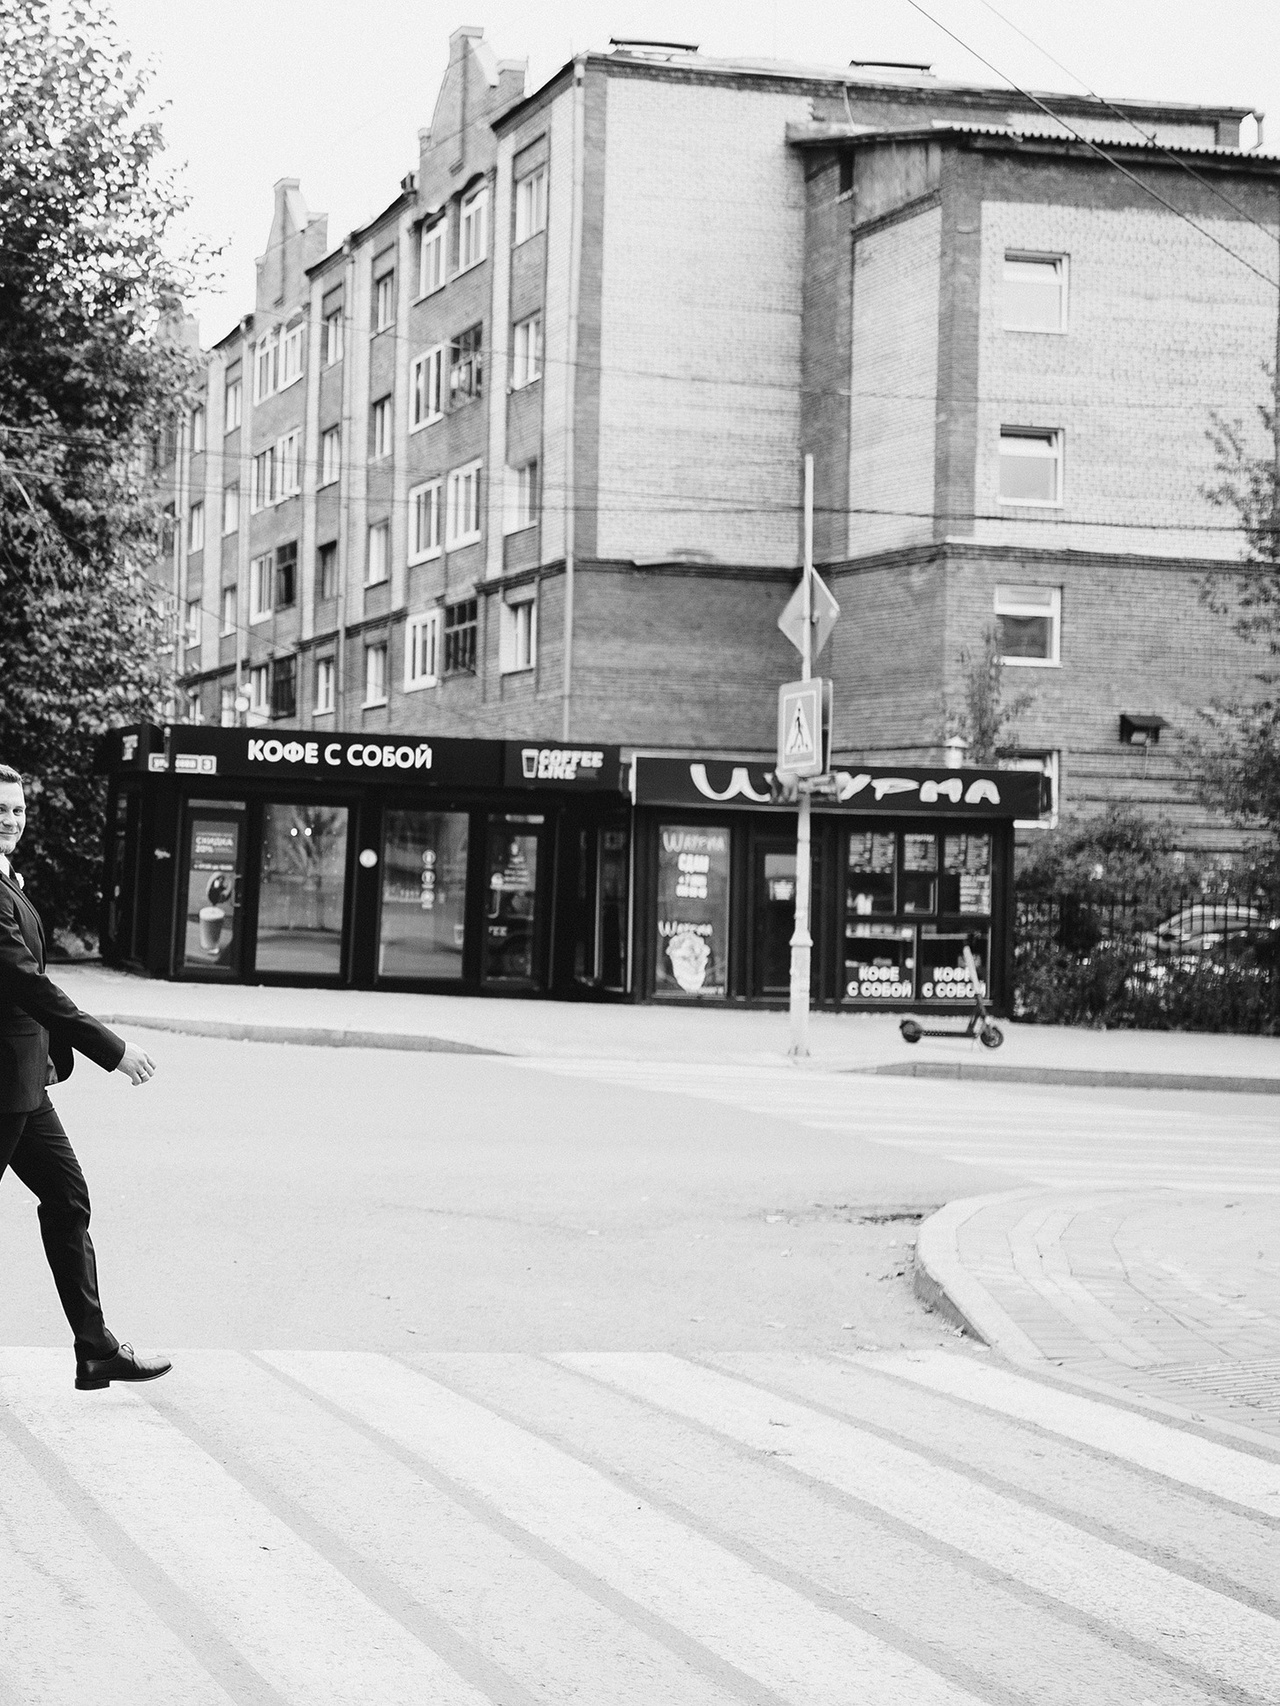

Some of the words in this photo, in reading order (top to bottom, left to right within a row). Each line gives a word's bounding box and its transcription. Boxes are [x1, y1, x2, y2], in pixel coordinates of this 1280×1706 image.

[248, 739, 319, 764] КОФЕ
[324, 743, 342, 766] С
[346, 743, 432, 769] СОБОЙ
[539, 749, 604, 768] COFFEE
[538, 765, 577, 779] LIKE
[690, 763, 1001, 804] ШУРМА
[858, 965, 900, 982] КОФЕ
[846, 981, 859, 997] С
[860, 980, 912, 998] СОБОЙ
[922, 982, 934, 997] С
